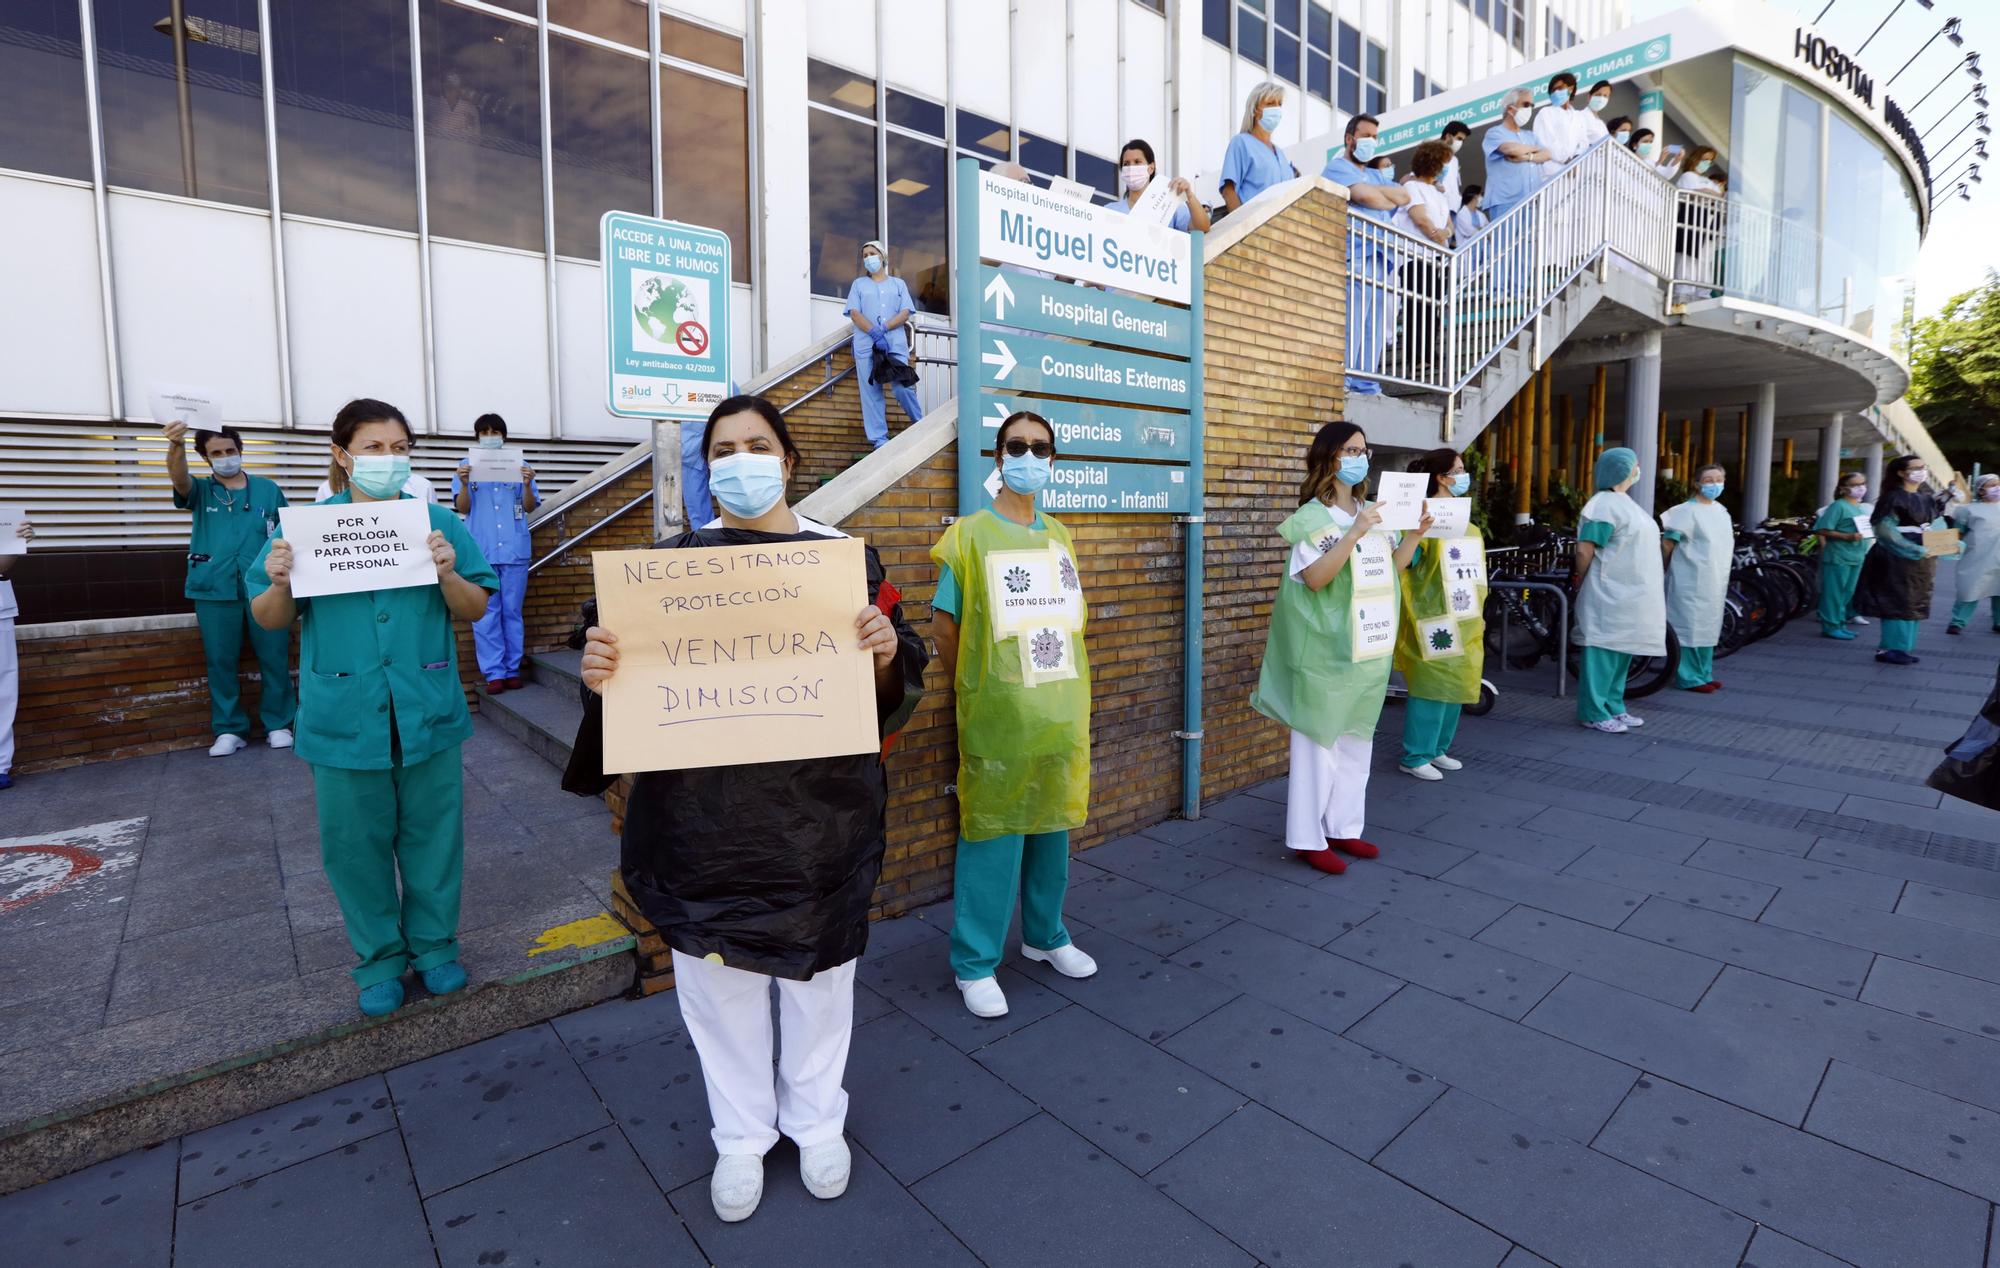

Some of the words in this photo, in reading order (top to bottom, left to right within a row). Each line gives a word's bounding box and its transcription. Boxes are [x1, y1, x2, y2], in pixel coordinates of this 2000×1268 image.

[1795, 27, 1875, 110] HOSPITAL
[1389, 128, 1414, 143] LIBRE
[1418, 124, 1431, 134] DE
[1481, 98, 1502, 114] GRA
[1533, 84, 1549, 97] PO
[1586, 53, 1634, 80] FUMAR
[986, 180, 1029, 204] Hospital
[1032, 193, 1093, 221] Universitario
[614, 227, 654, 246] ACCEDE
[658, 234, 665, 248] A
[669, 237, 692, 252] UNA
[695, 242, 723, 258] ZONA
[1000, 208, 1093, 263] Miguel
[1103, 238, 1178, 285] Servet
[619, 246, 651, 264] LIBRE
[656, 252, 671, 267] DE
[676, 255, 719, 275] HUMOS
[1041, 295, 1107, 326] Hospital
[1112, 309, 1167, 338] General
[626, 357, 640, 370] Ley
[643, 358, 683, 372] antitabaco
[685, 362, 715, 374] 42/2010
[1041, 355, 1122, 385] Consultas
[1126, 367, 1186, 394] Externas
[622, 385, 652, 397] salud
[1042, 488, 1107, 509] Materno
[1121, 491, 1169, 509] Infantil
[322, 529, 398, 543] SEROLOGIA
[337, 517, 364, 528] PCR
[371, 516, 380, 526] Y
[315, 547, 351, 558] PARA
[354, 544, 390, 555] TODO
[394, 542, 409, 552] EL
[329, 557, 399, 572] PERSONAL
[624, 550, 822, 585] NECESITAMOS
[660, 582, 802, 614] PROTECCIÓN
[1005, 598, 1025, 607] ESTO
[1026, 598, 1037, 606] NO
[1039, 597, 1047, 605] ES
[1048, 597, 1057, 605] UN
[662, 631, 839, 667] VENTURA
[658, 675, 824, 713] DIMISIÓN
